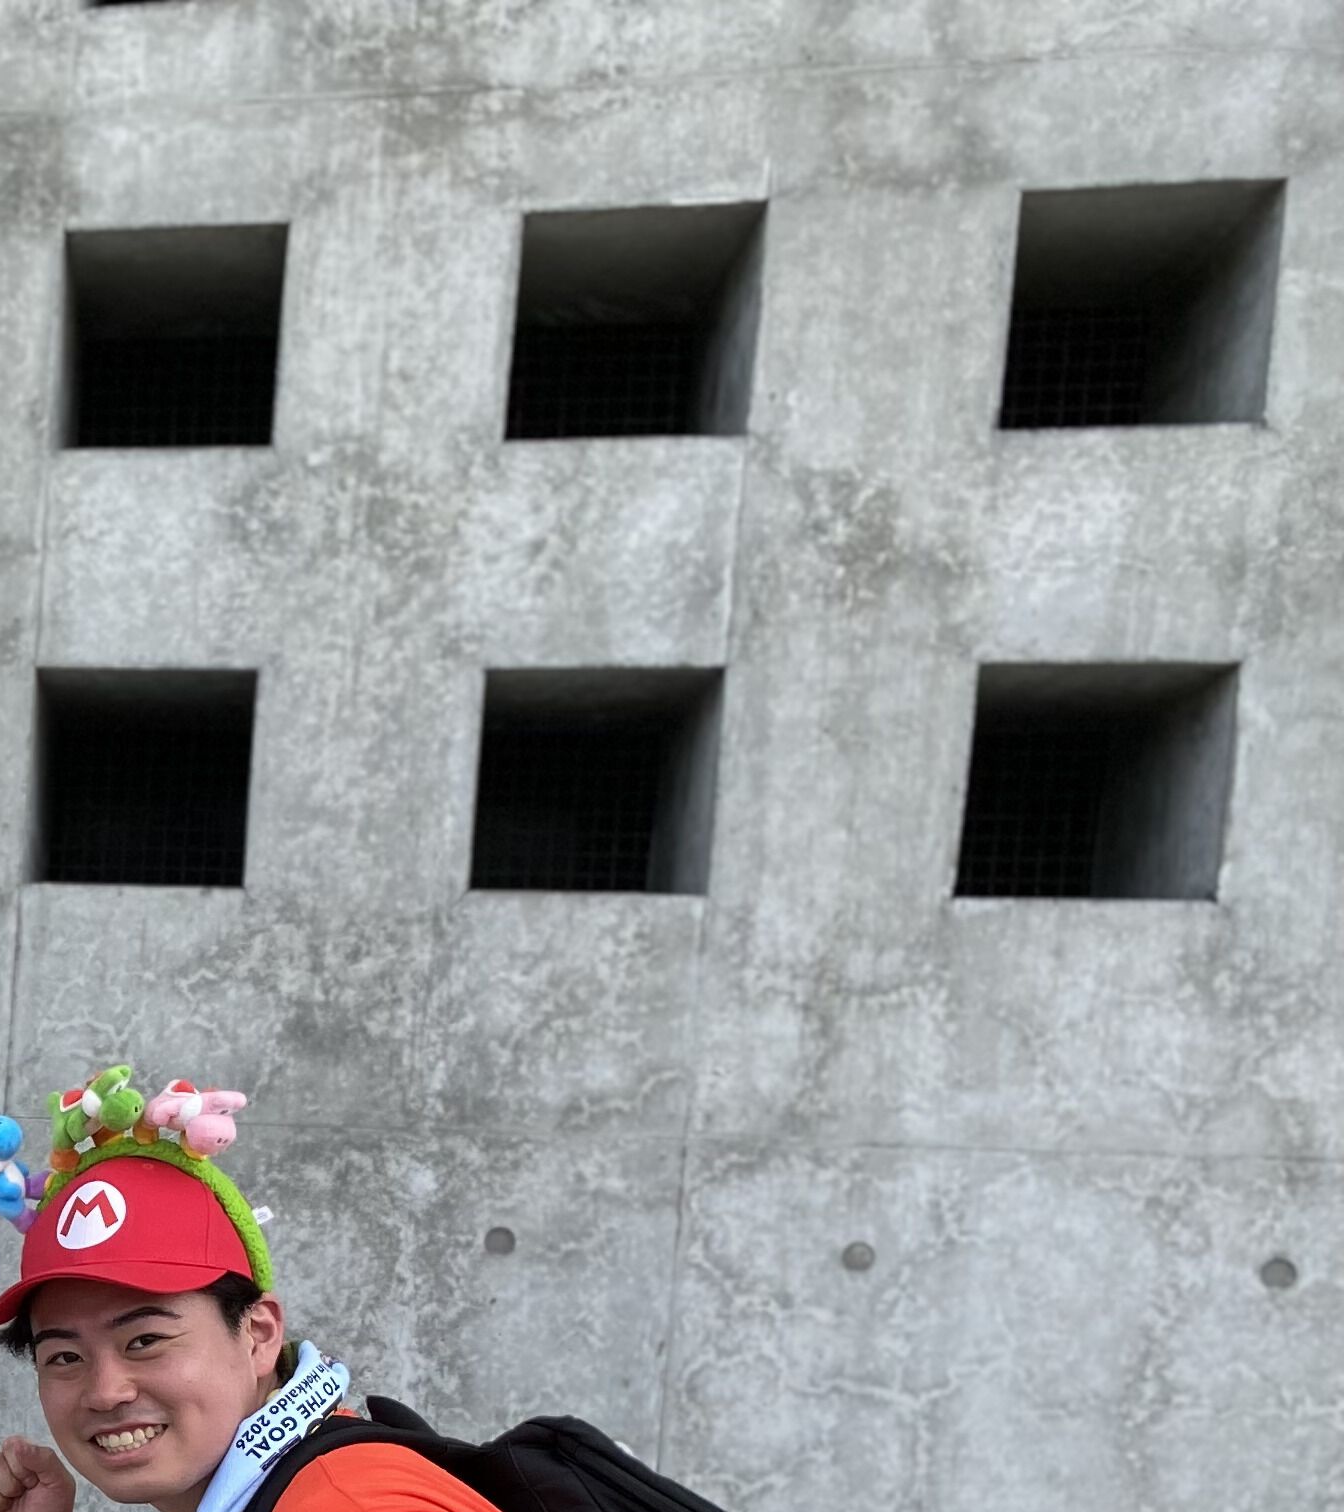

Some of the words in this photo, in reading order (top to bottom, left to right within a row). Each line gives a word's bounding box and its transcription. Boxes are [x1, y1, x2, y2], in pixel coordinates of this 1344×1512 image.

[59, 1189, 119, 1237] M
[269, 1370, 321, 1415] Hokkaido
[322, 1375, 341, 1396] TO
[296, 1391, 327, 1420] THE
[235, 1415, 271, 1450] 2026
[245, 1416, 298, 1459] GOAL
